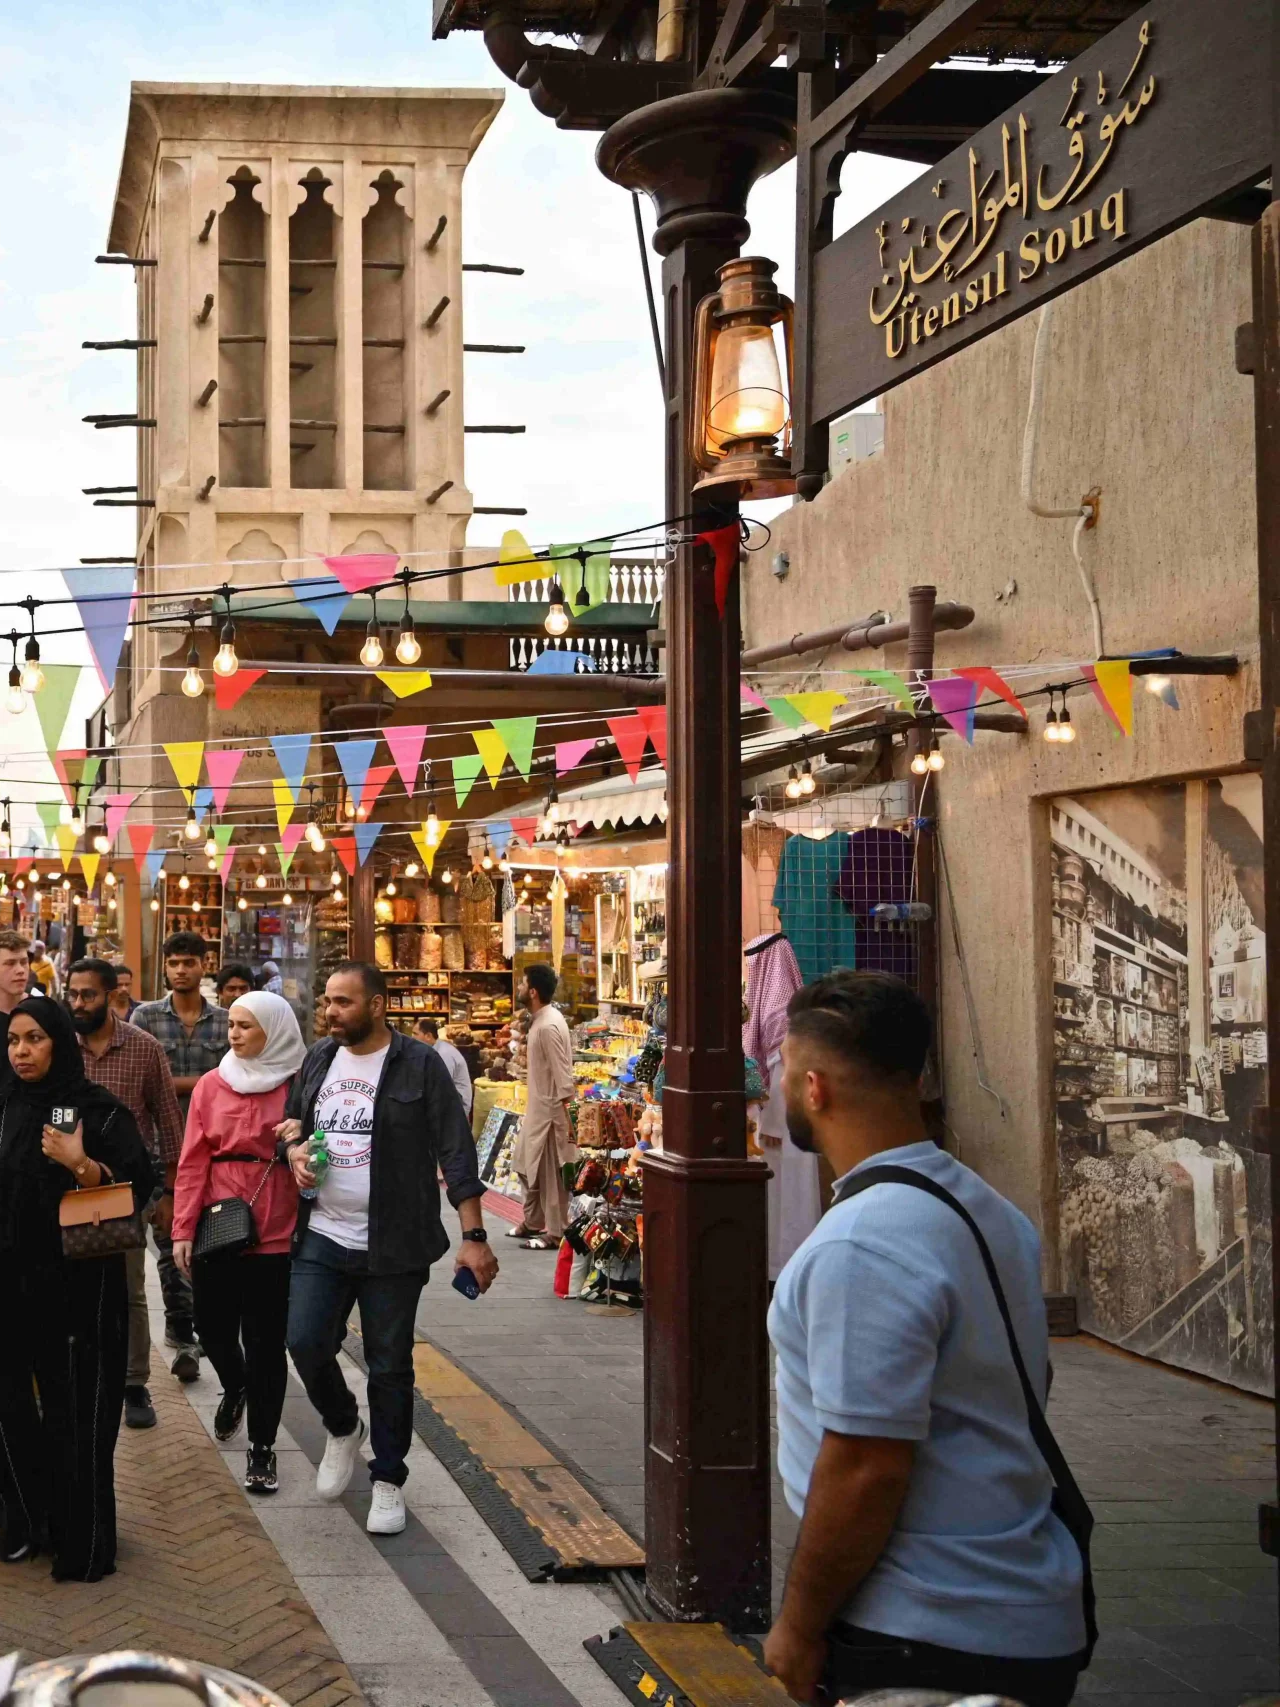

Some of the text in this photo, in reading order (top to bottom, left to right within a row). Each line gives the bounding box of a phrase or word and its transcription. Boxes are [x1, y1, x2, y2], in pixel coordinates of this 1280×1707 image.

[884, 187, 1129, 358] Utensil Souq
[314, 1081, 376, 1106] THE SUPER
[336, 1139, 353, 1147] 1990
[328, 1154, 350, 1165] AFTED
